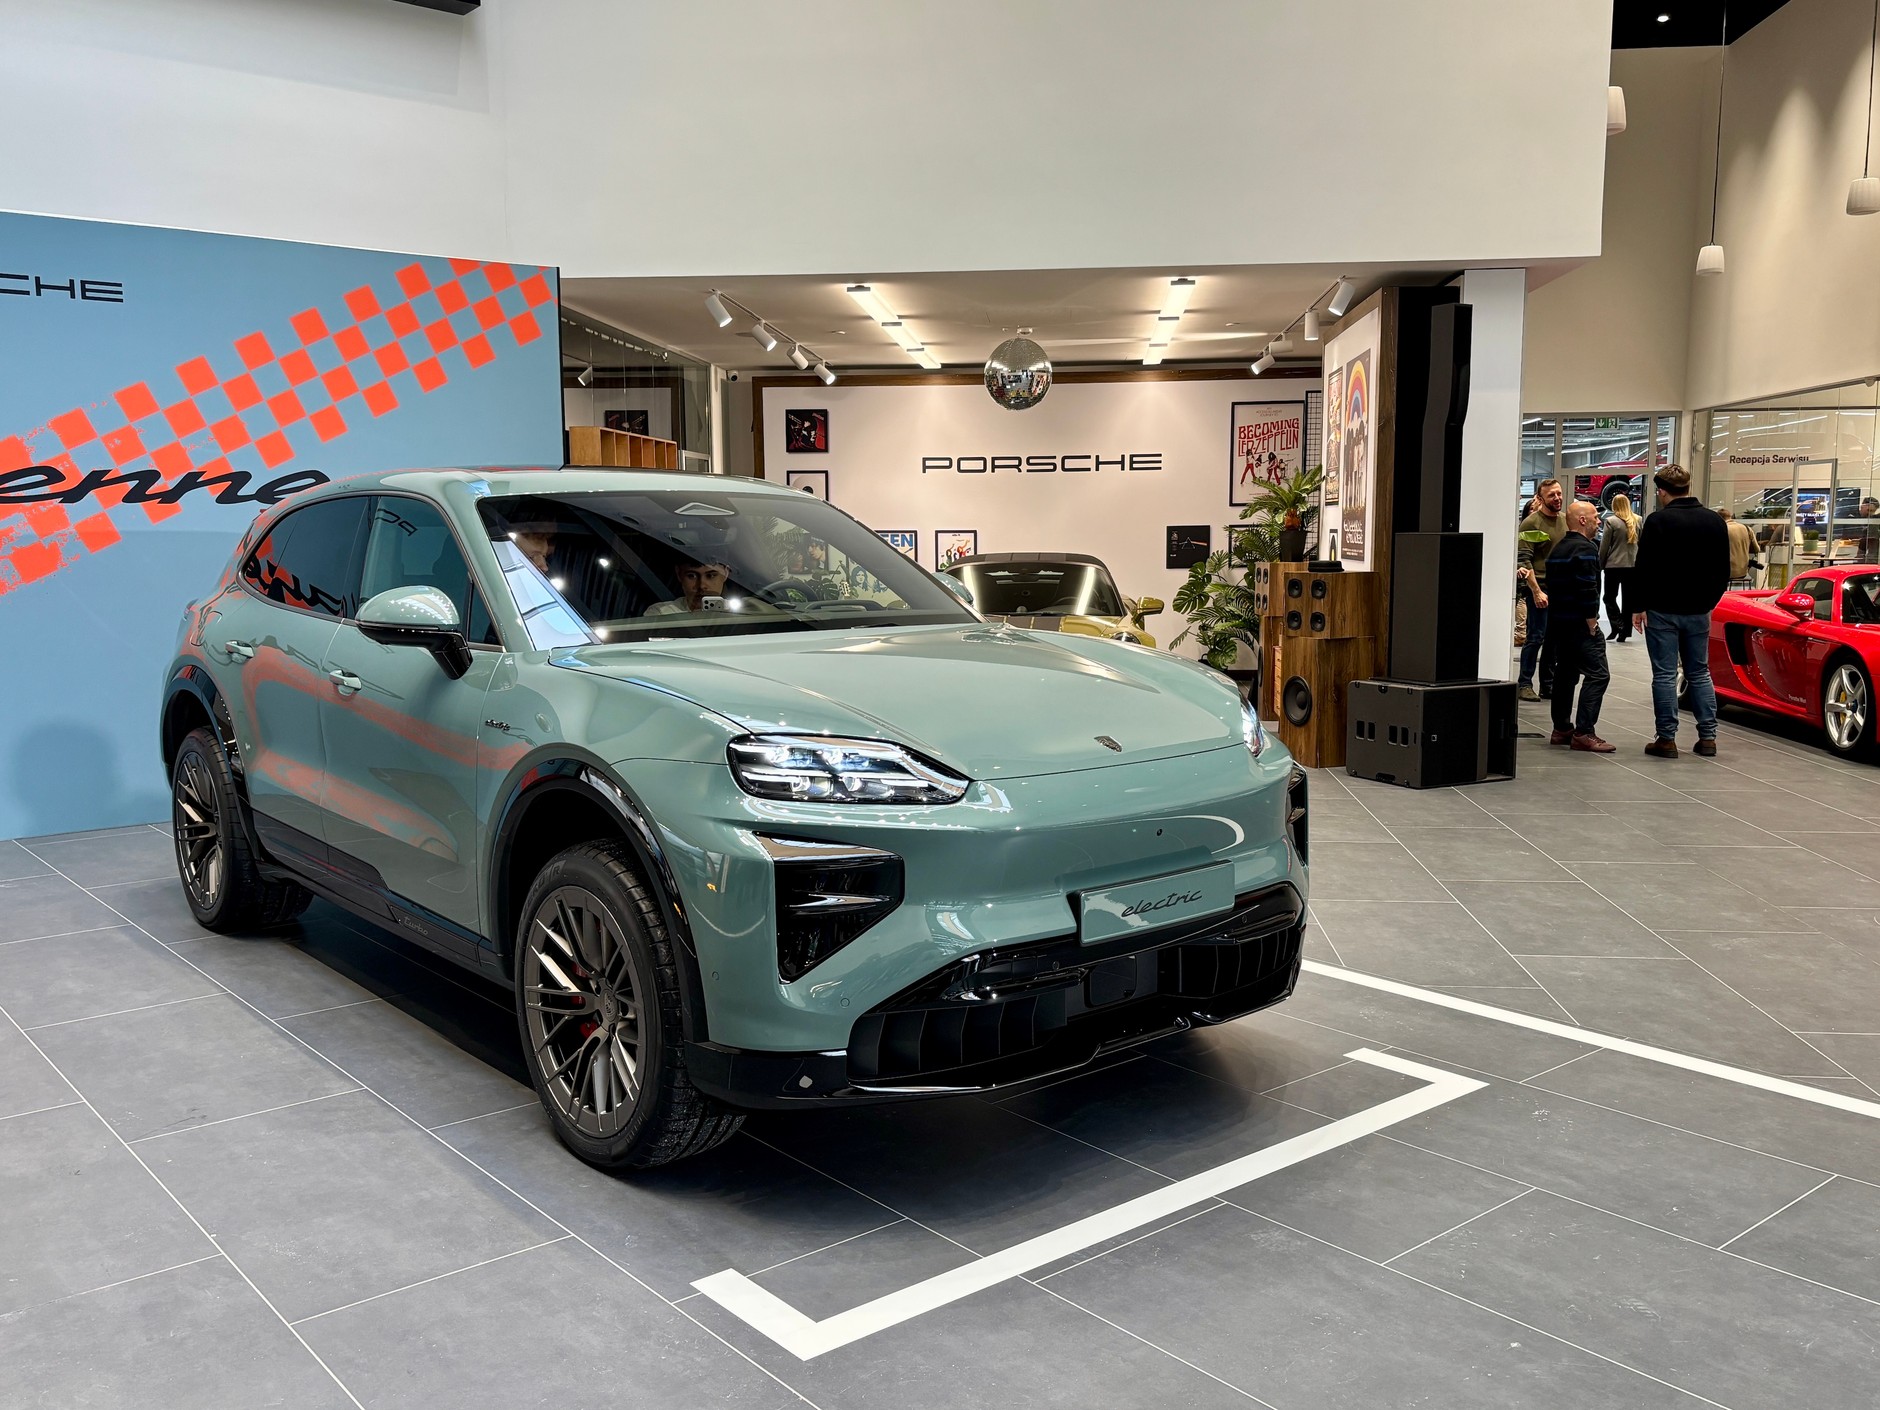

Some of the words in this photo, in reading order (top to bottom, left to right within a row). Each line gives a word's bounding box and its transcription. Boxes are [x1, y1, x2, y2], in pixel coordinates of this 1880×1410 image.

[1238, 418, 1300, 440] BECOMING
[922, 453, 1163, 474] PORSCHE
[1729, 454, 1770, 465] Recepcja
[1121, 890, 1203, 918] electric
[403, 916, 429, 936] turbo
